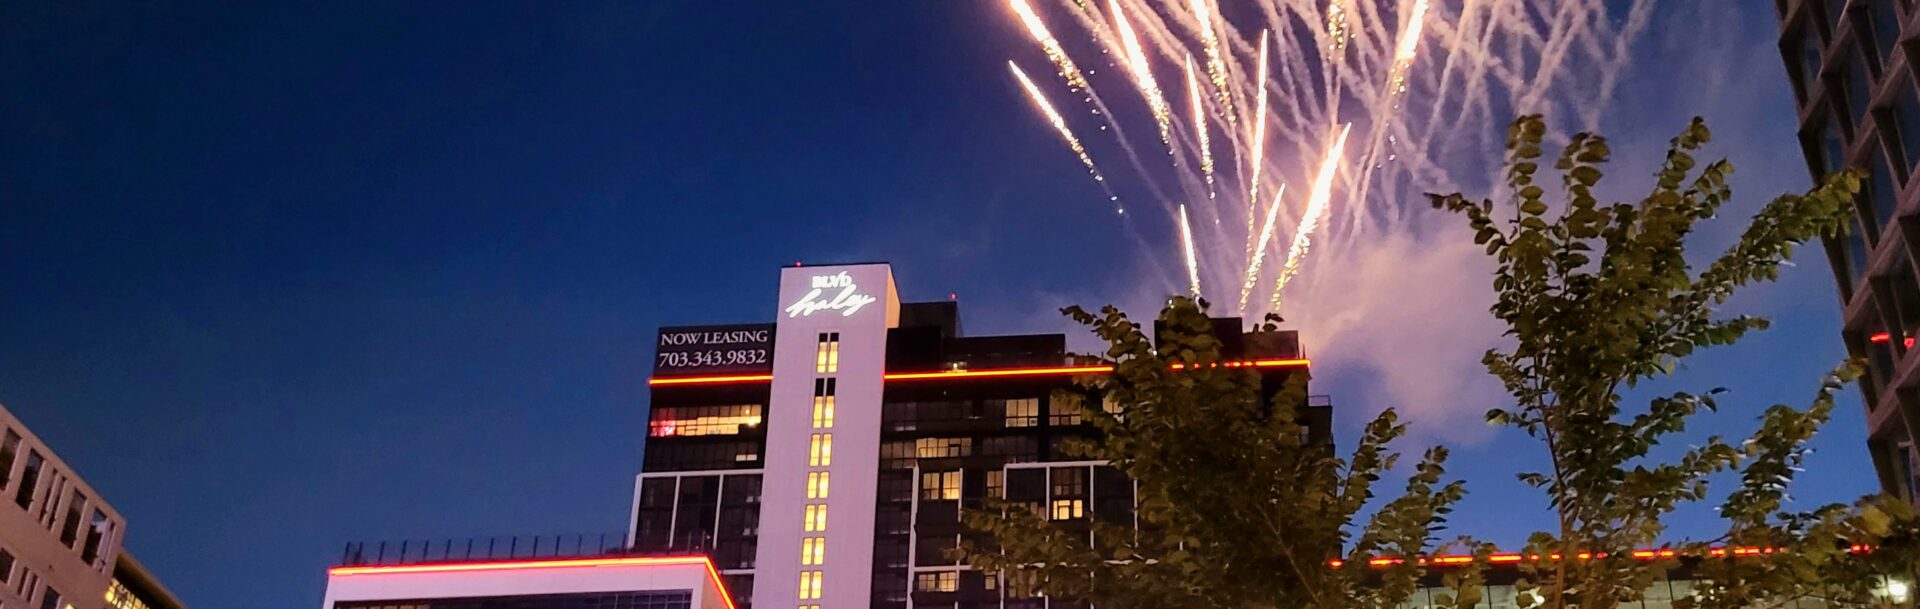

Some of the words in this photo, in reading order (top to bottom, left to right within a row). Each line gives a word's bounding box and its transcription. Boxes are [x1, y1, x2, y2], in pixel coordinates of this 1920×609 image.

[811, 271, 853, 288] BLVD
[661, 333, 701, 346] NOW
[703, 330, 768, 344] LEASING
[659, 349, 766, 367] 703.343.9832
